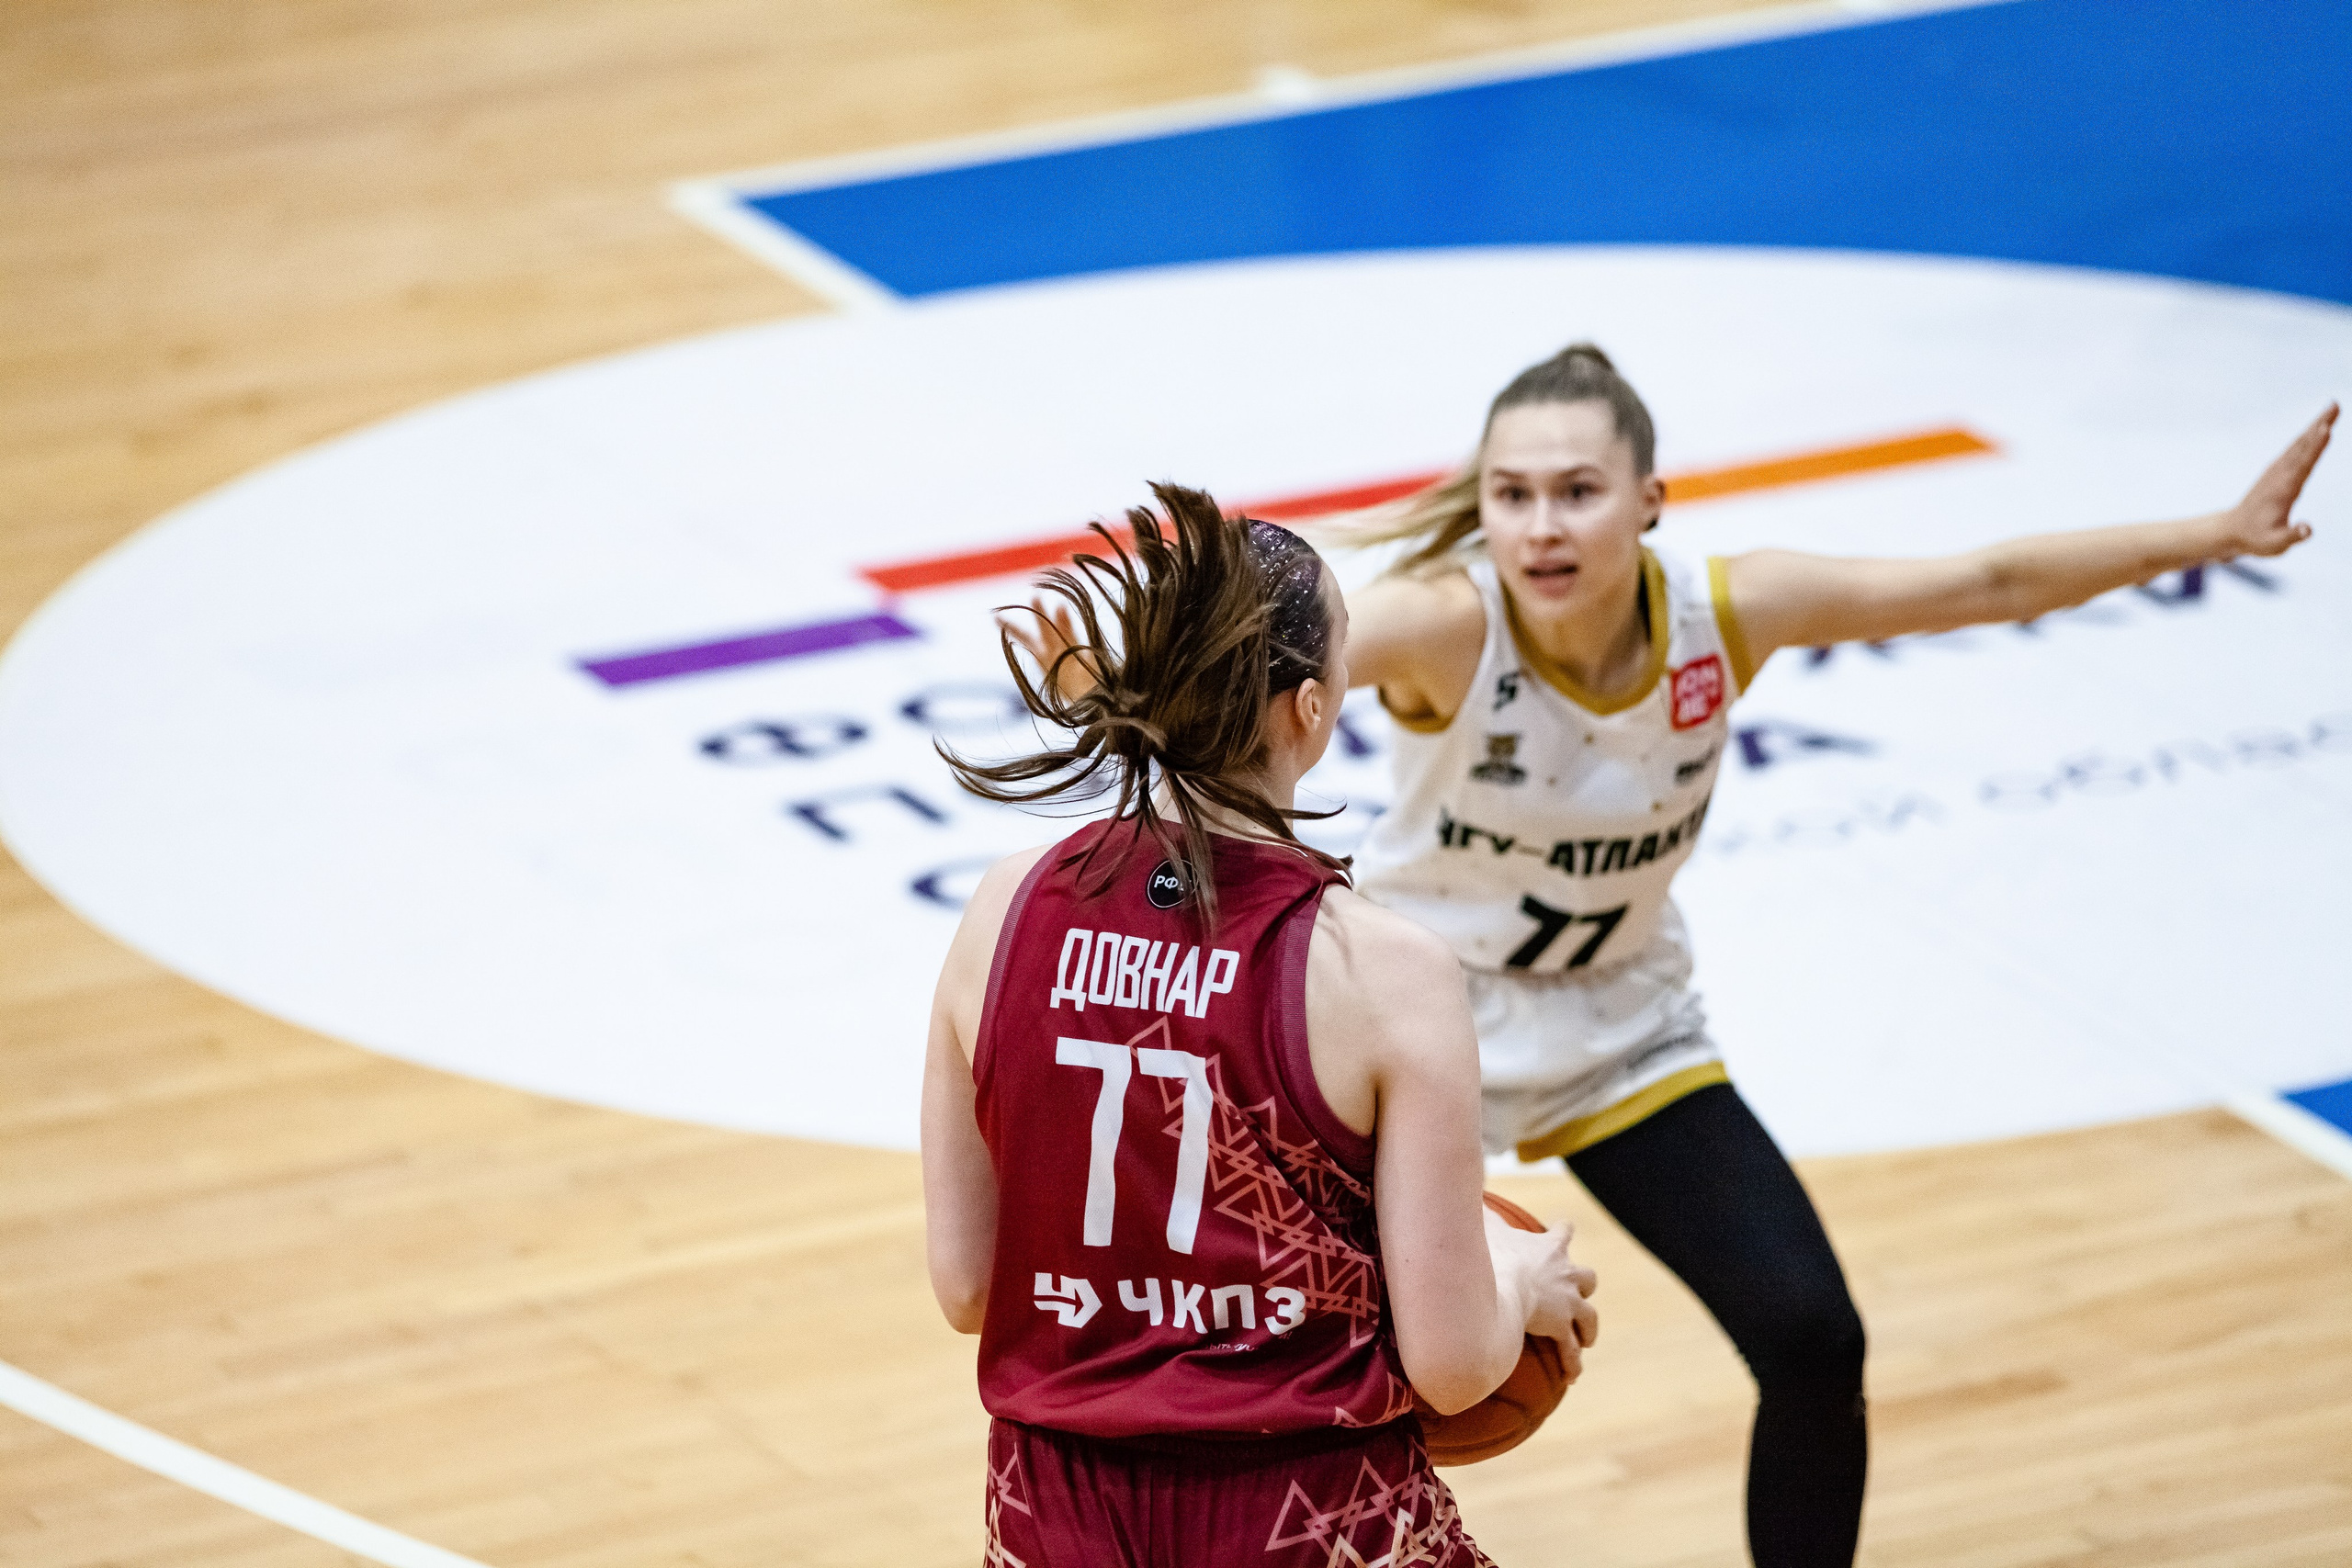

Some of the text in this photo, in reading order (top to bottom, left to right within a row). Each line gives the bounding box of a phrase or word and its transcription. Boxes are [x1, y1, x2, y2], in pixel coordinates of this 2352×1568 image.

[1153, 874, 1192, 893] РФ
[1502, 891, 1630, 970] 77
[1049, 928, 1240, 1019] ДОВНАР
[1055, 1036, 1215, 1255] 77
[1117, 1277, 1306, 1336] ЧКПЗ
